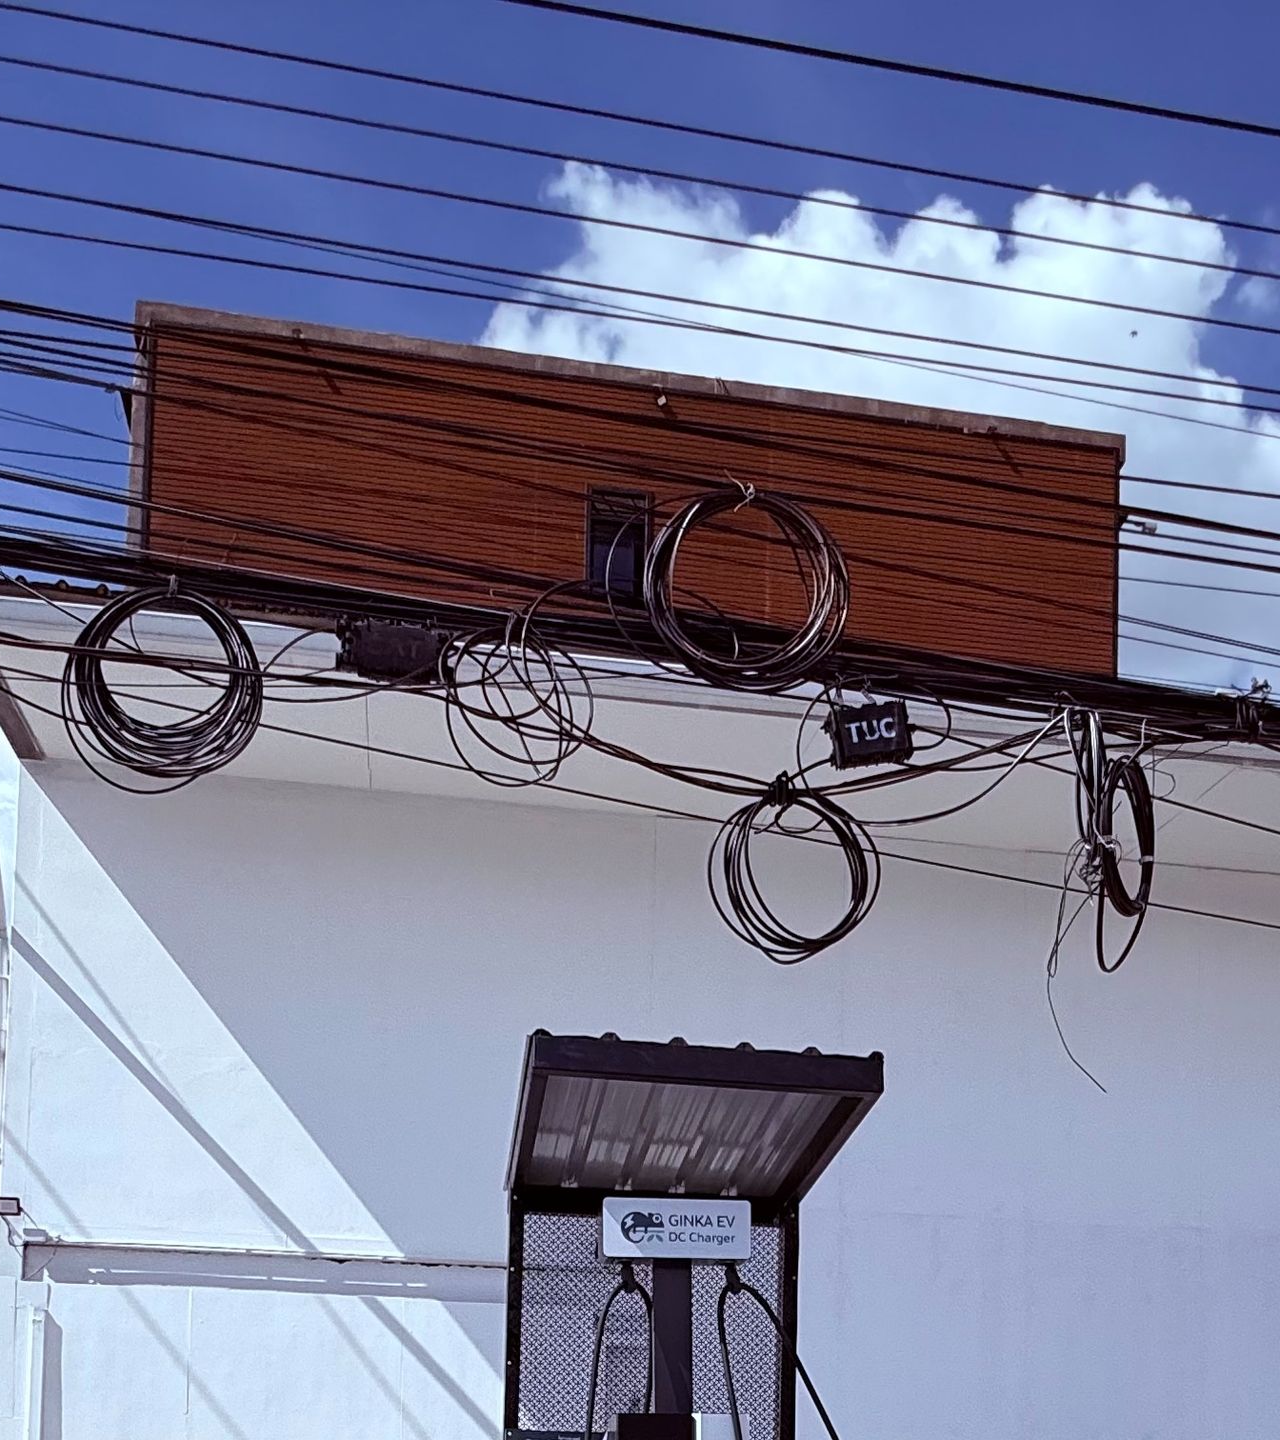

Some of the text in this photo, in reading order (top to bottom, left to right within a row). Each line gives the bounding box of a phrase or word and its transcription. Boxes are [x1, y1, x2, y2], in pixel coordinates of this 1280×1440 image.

[844, 716, 897, 744] TUC
[668, 1214, 736, 1228] GINKA EV
[668, 1231, 736, 1246] DC Charger
